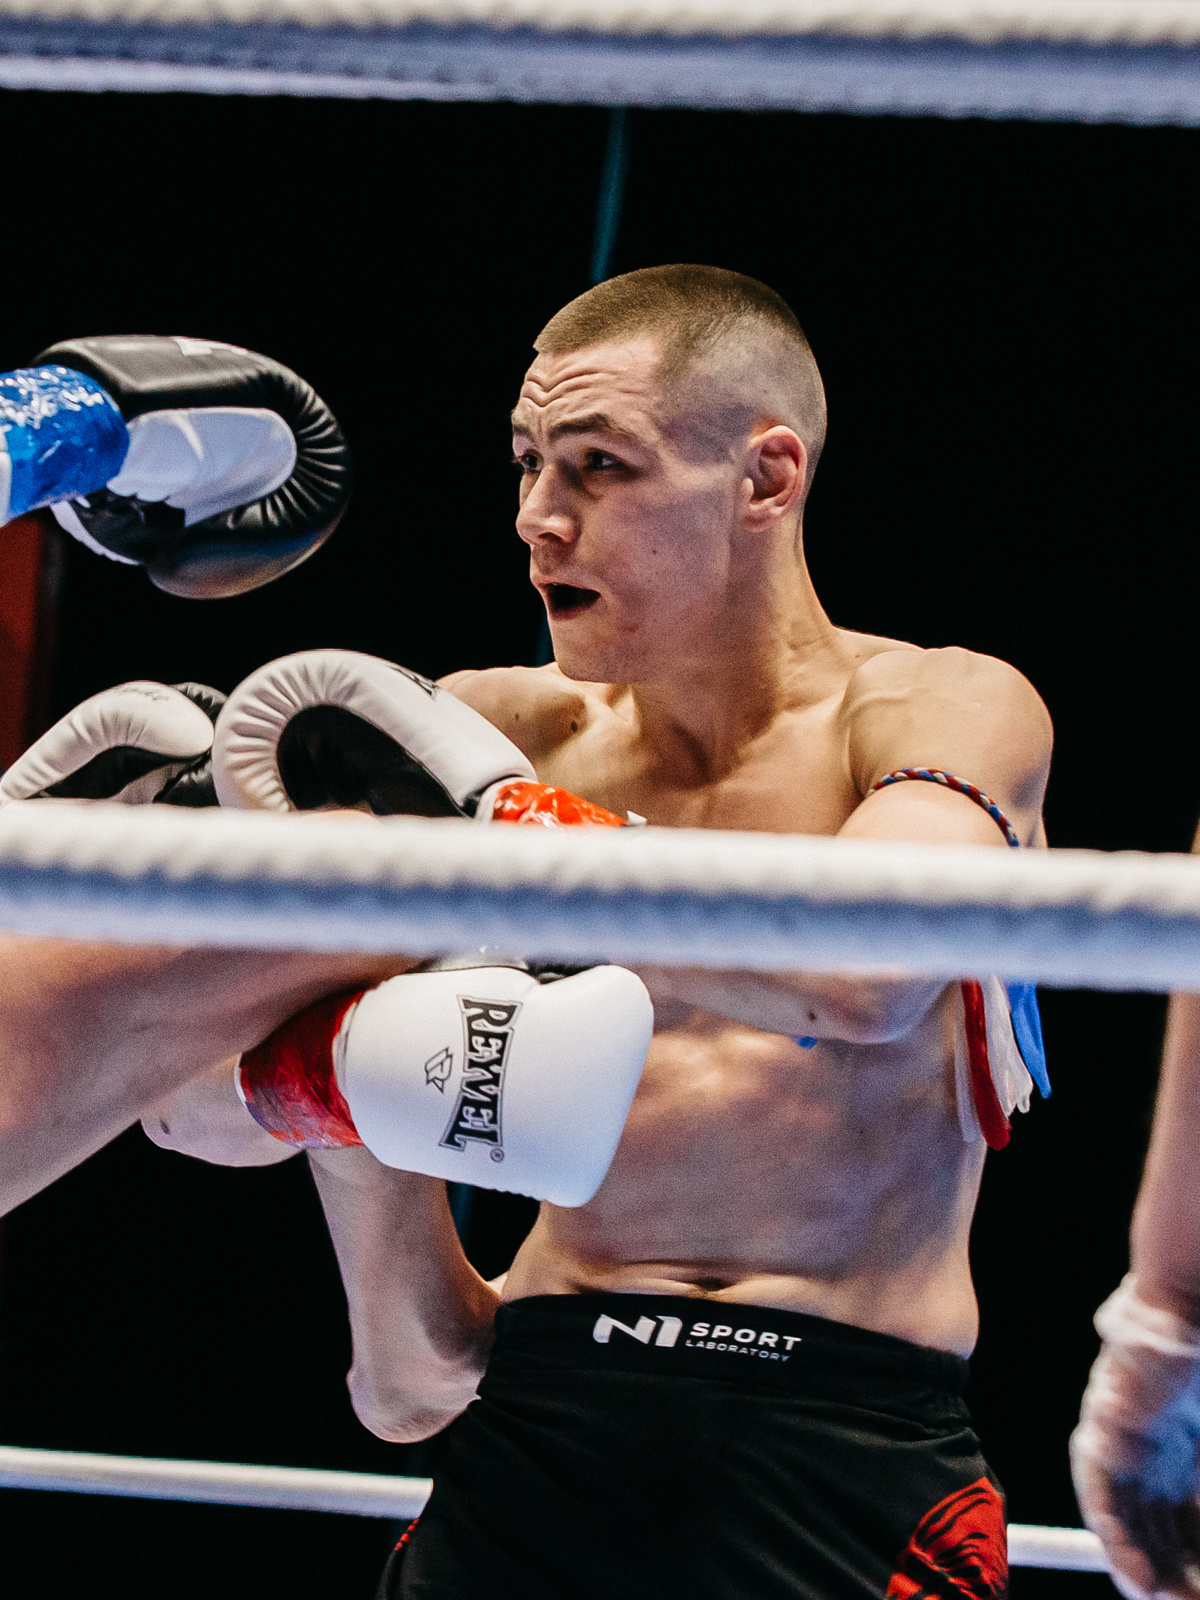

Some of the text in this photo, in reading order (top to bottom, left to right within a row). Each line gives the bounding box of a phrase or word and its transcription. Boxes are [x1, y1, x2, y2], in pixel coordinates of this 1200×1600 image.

[439, 994, 522, 1151] REYVEL
[689, 1322, 802, 1350] SPORT
[685, 1339, 790, 1362] LABORATORY
